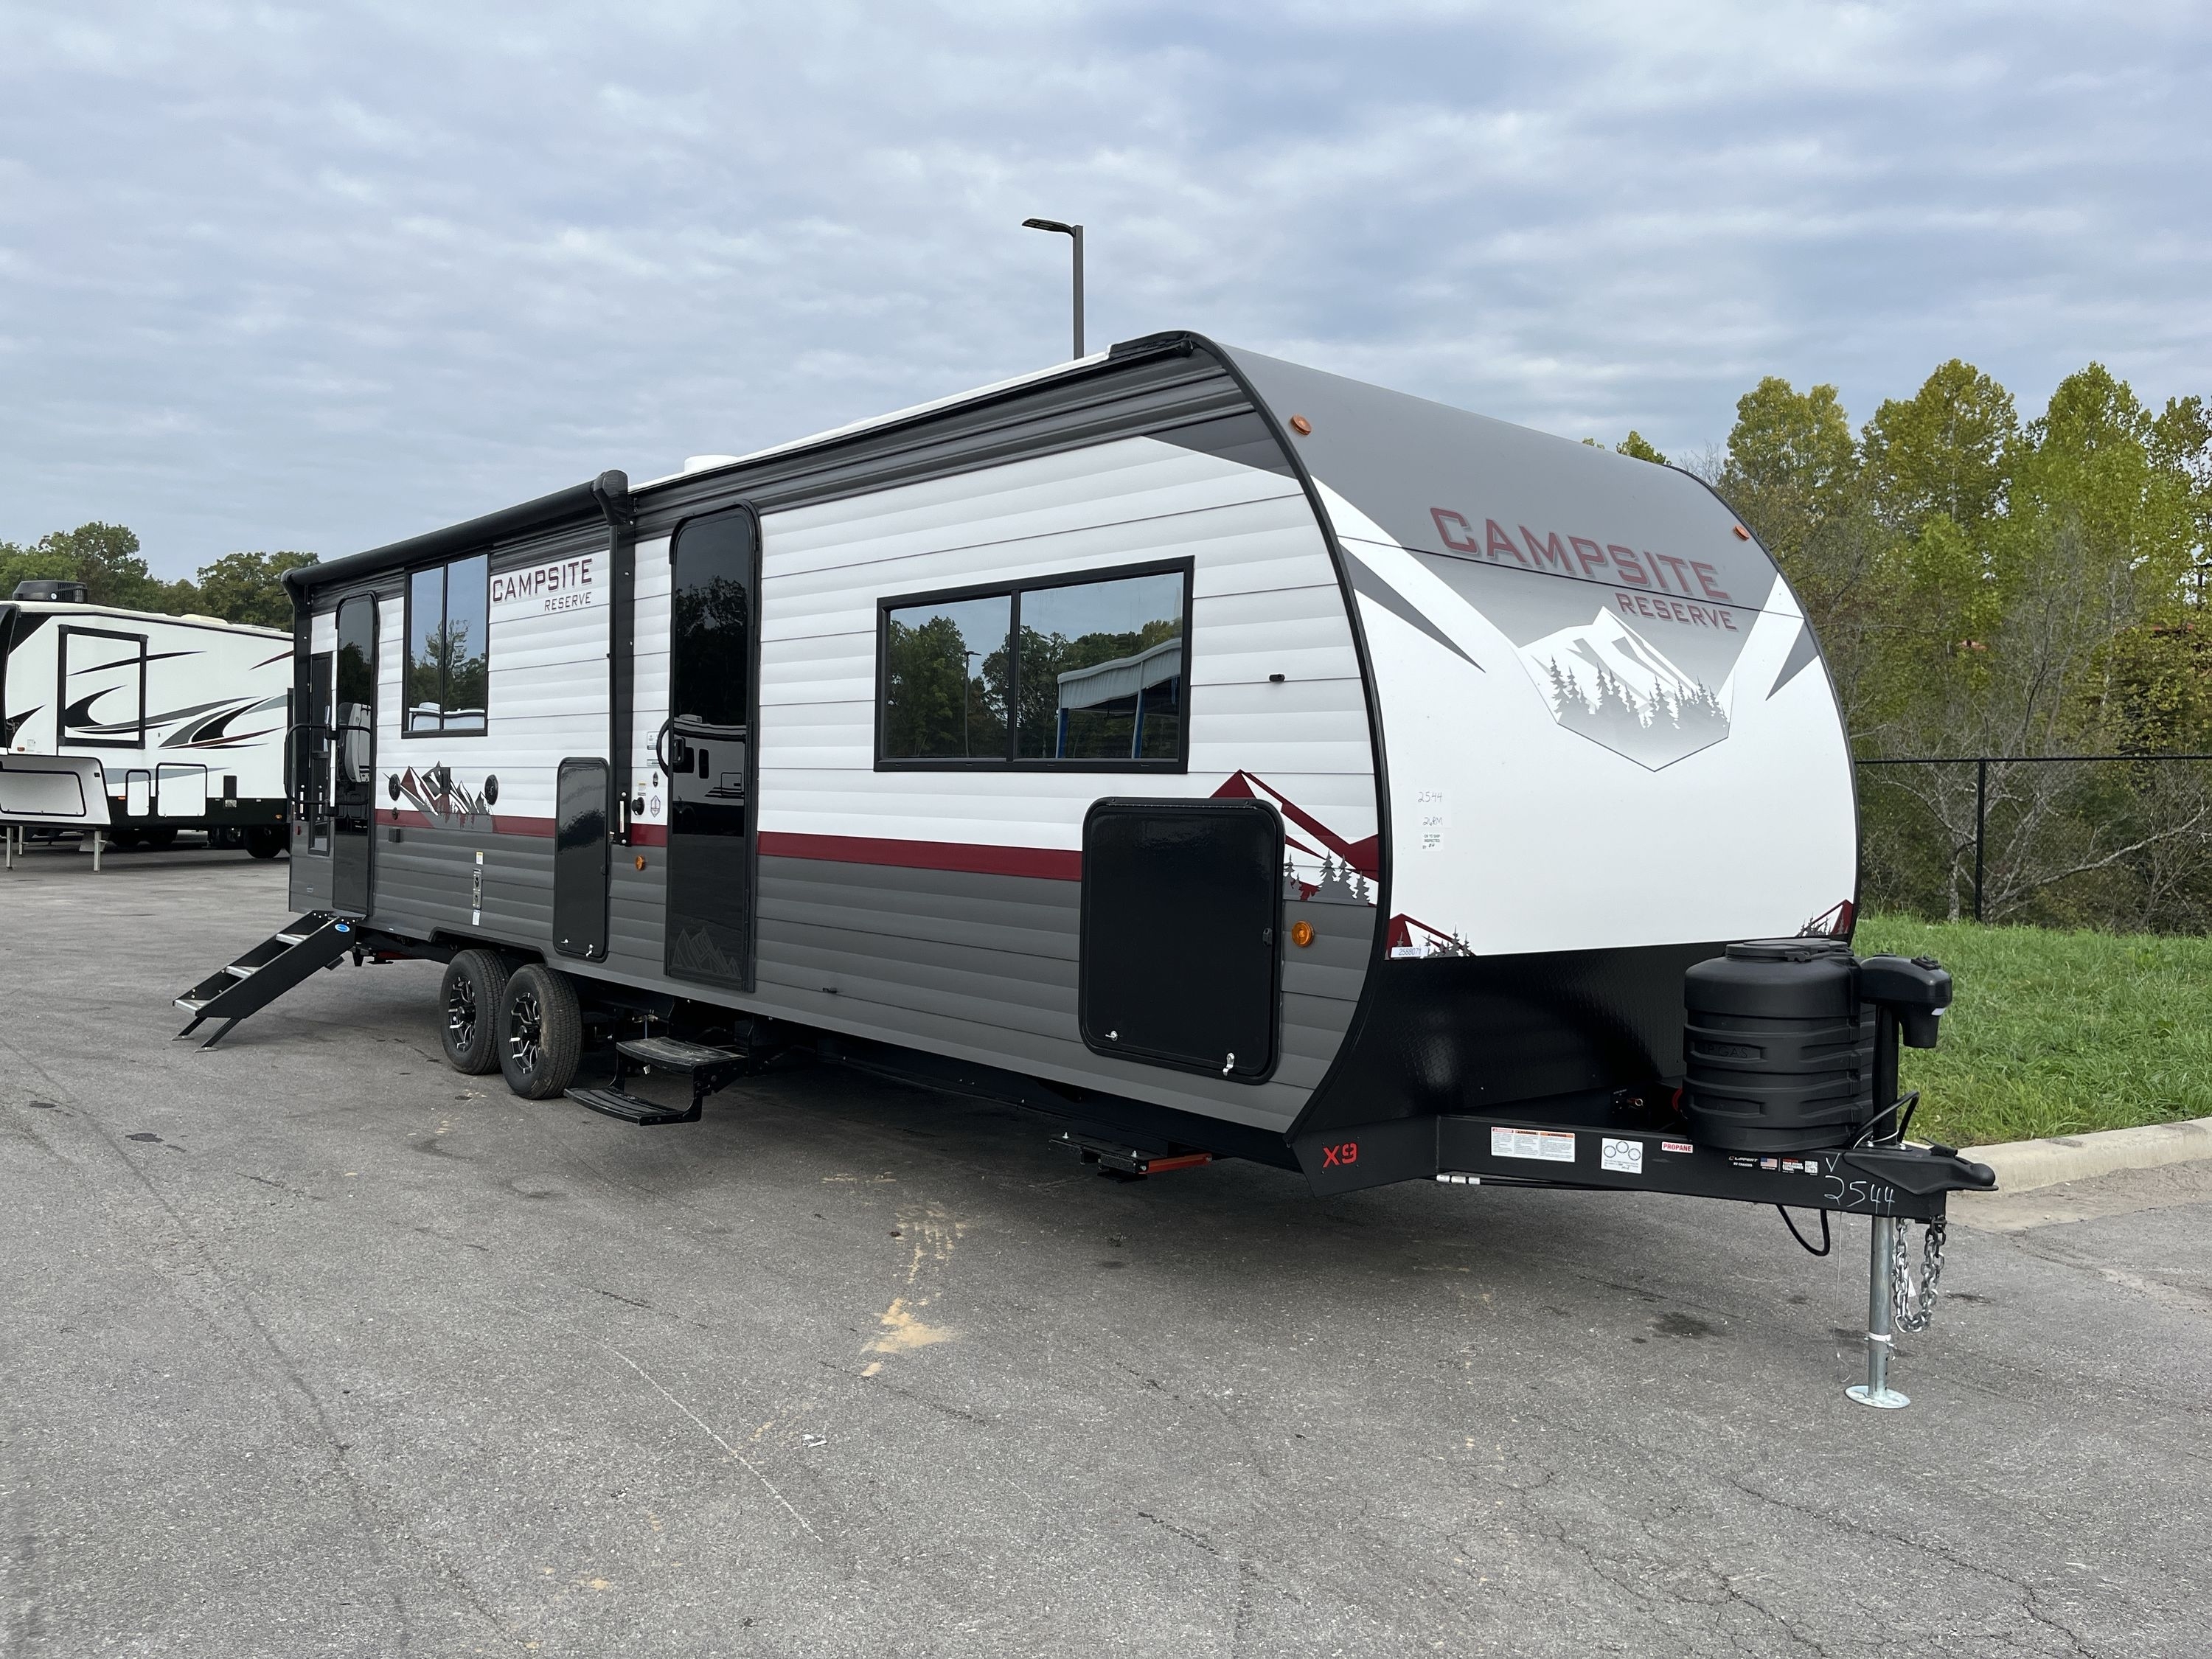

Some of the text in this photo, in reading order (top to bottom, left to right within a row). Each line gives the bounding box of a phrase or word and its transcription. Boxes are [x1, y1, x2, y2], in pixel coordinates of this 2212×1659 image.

[1430, 507, 1731, 599] CAMPSITE
[493, 558, 592, 602] CAMPSITE
[544, 591, 591, 611] RESERVE
[1615, 592, 1738, 630] RESERVE
[1417, 791, 1442, 802] 2544
[1718, 1046, 1748, 1058] GAS
[1323, 1142, 1357, 1168] X9
[1663, 1143, 1691, 1152] PROPANE
[1824, 1175, 1896, 1217] 2544
